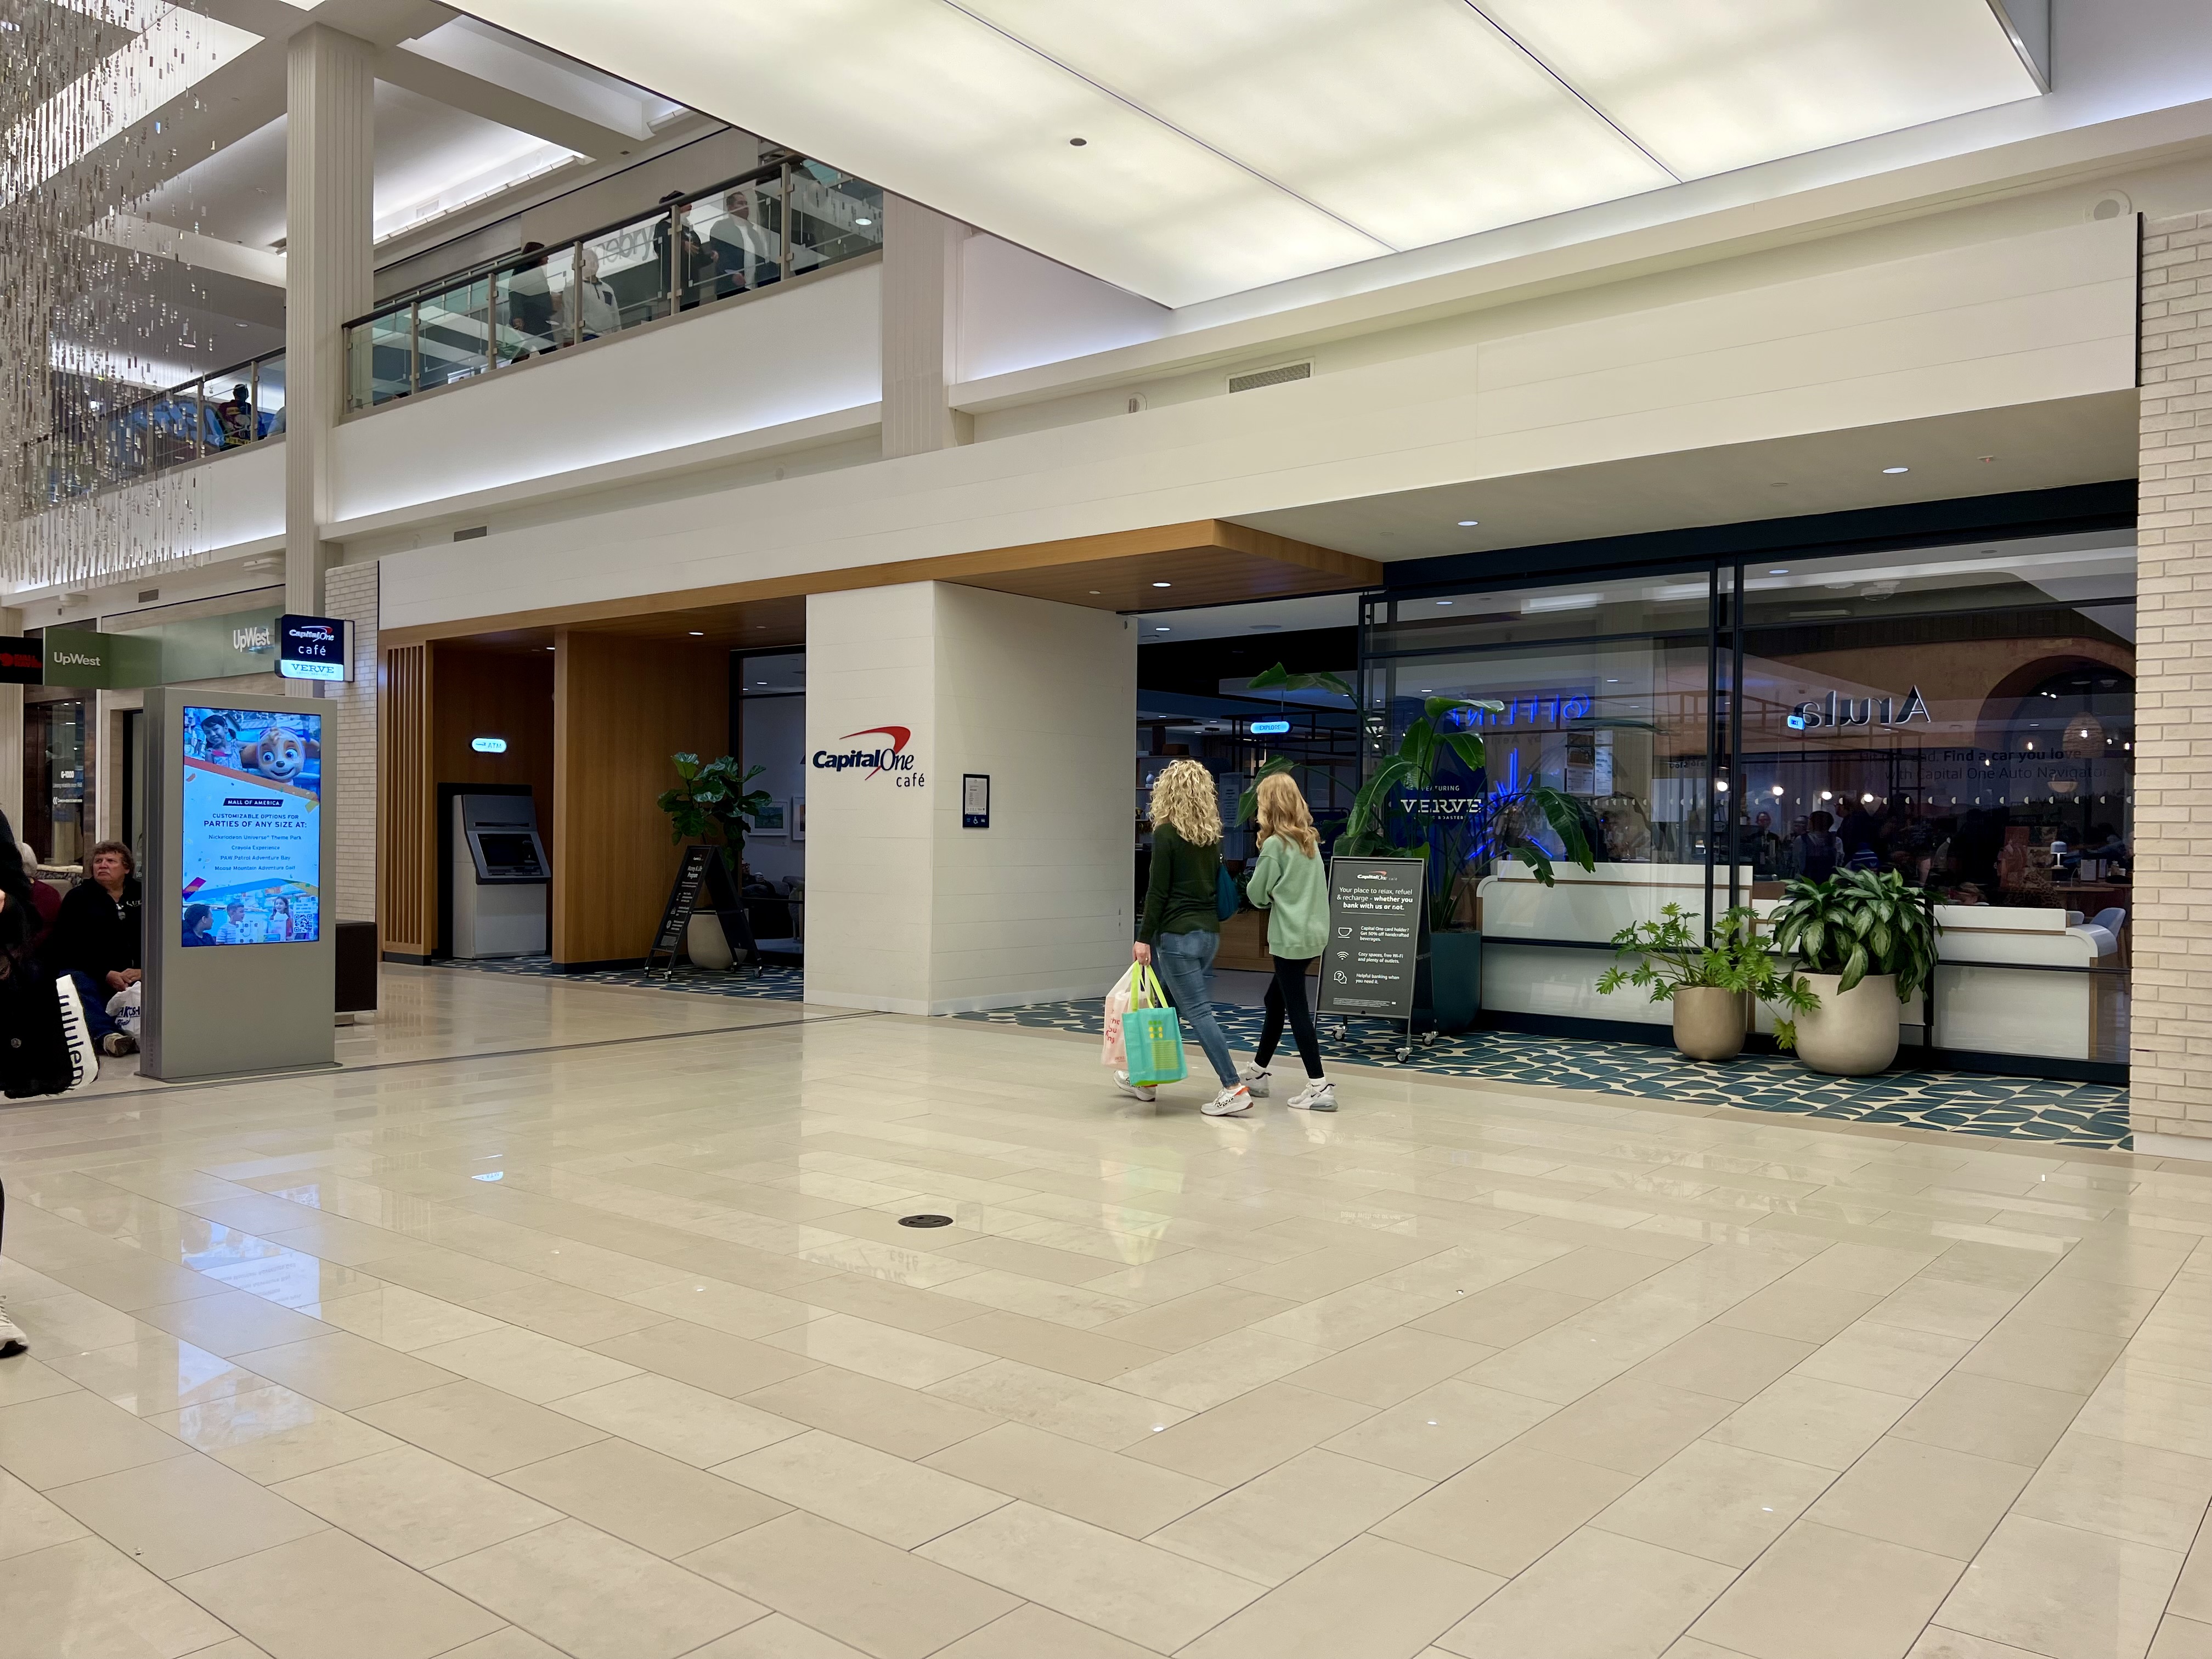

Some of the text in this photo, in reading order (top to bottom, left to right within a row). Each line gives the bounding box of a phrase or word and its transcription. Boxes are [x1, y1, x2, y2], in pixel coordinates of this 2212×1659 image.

[233, 627, 270, 652] UpWest
[298, 645, 326, 656] café
[54, 652, 100, 666] UpWest
[291, 663, 334, 674] VERVE
[1944, 749, 1974, 761] Find
[1978, 752, 1986, 761] a
[1991, 752, 2013, 760] car
[2018, 751, 2045, 763] you
[2051, 748, 2082, 760] love
[896, 772, 925, 787] café
[1967, 768, 1995, 780] One
[2000, 767, 2032, 779] Auto
[1400, 799, 1481, 813] VERVE
